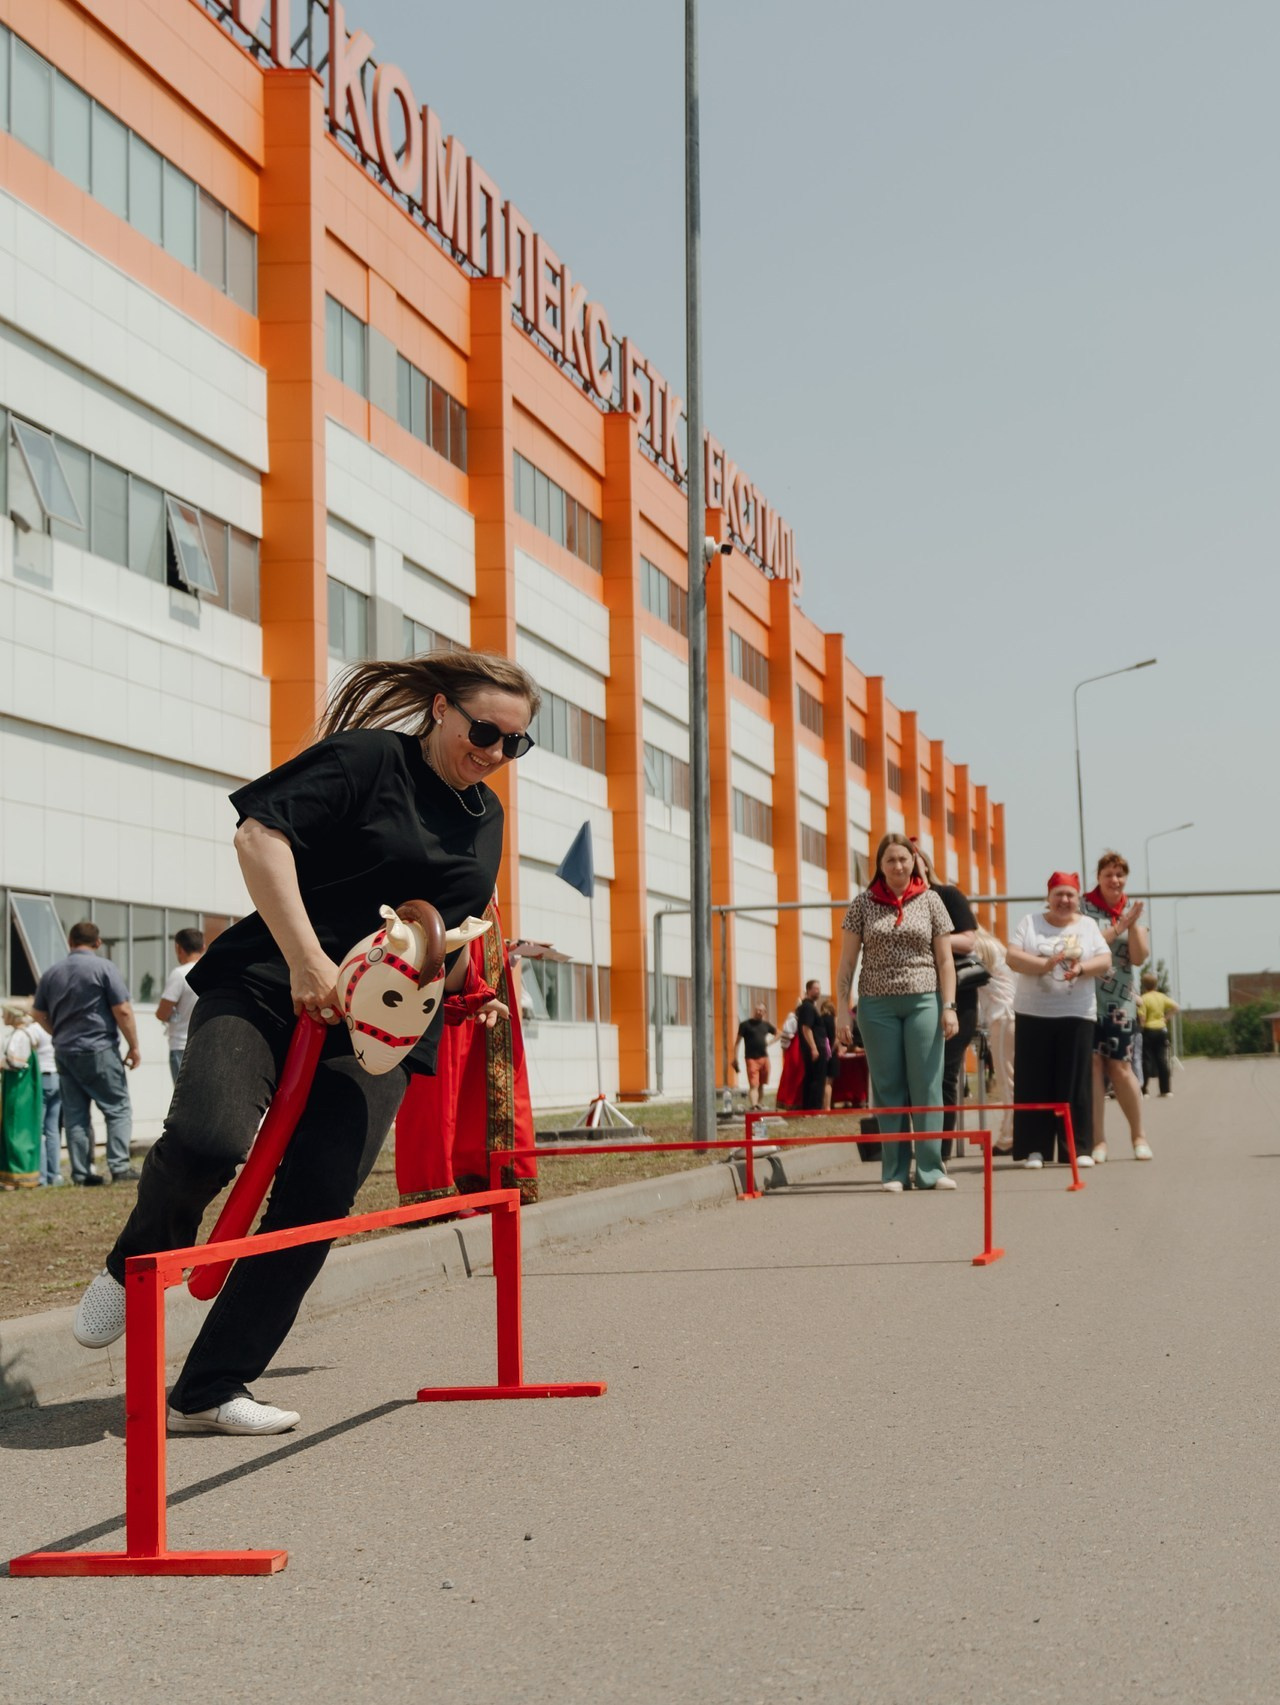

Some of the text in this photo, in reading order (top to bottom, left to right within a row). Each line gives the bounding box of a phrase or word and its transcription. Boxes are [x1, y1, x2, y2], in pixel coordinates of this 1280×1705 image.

[329, 0, 804, 599] КОМПЛЕКС БТК ЕКСТИЛЬ
